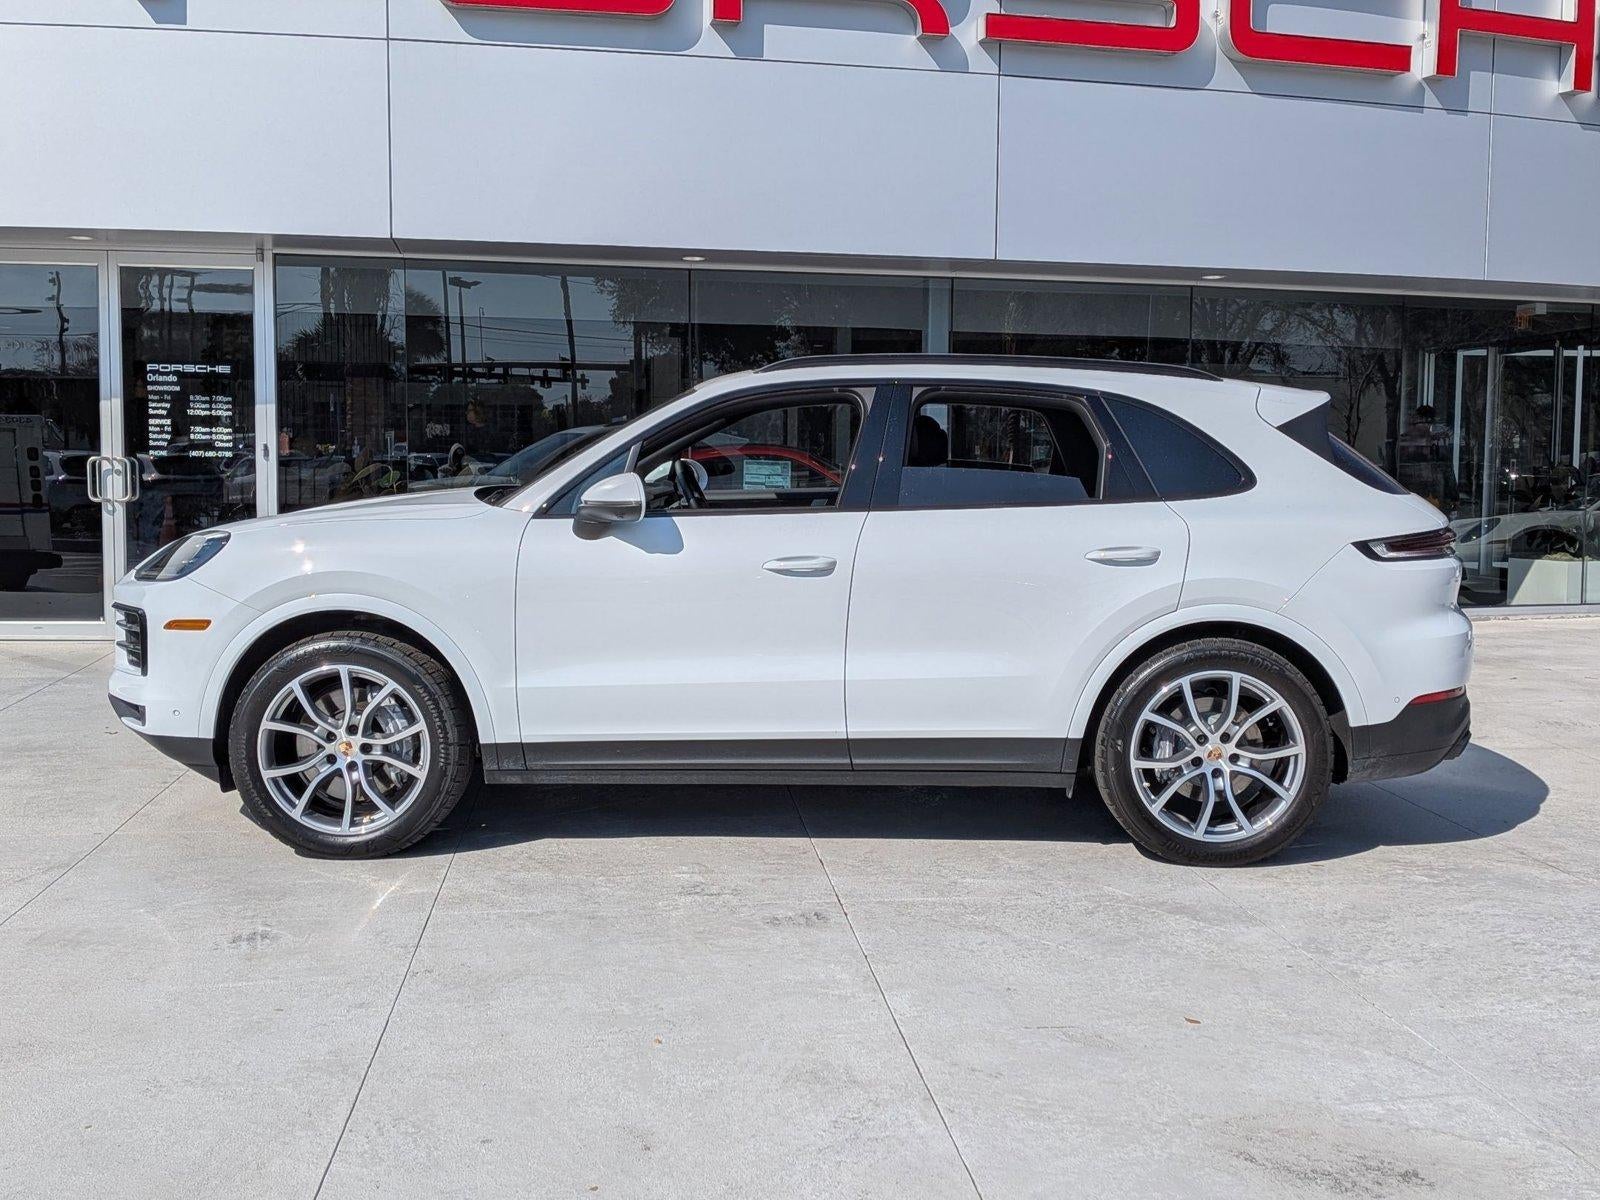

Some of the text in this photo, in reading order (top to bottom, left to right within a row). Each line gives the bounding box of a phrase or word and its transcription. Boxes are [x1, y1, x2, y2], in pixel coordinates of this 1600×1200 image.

[146, 363, 231, 373] PORSCHE
[146, 373, 178, 382] Orlando
[148, 401, 171, 409] Saturday
[148, 408, 168, 416] Sunday
[189, 450, 204, 458] (407)
